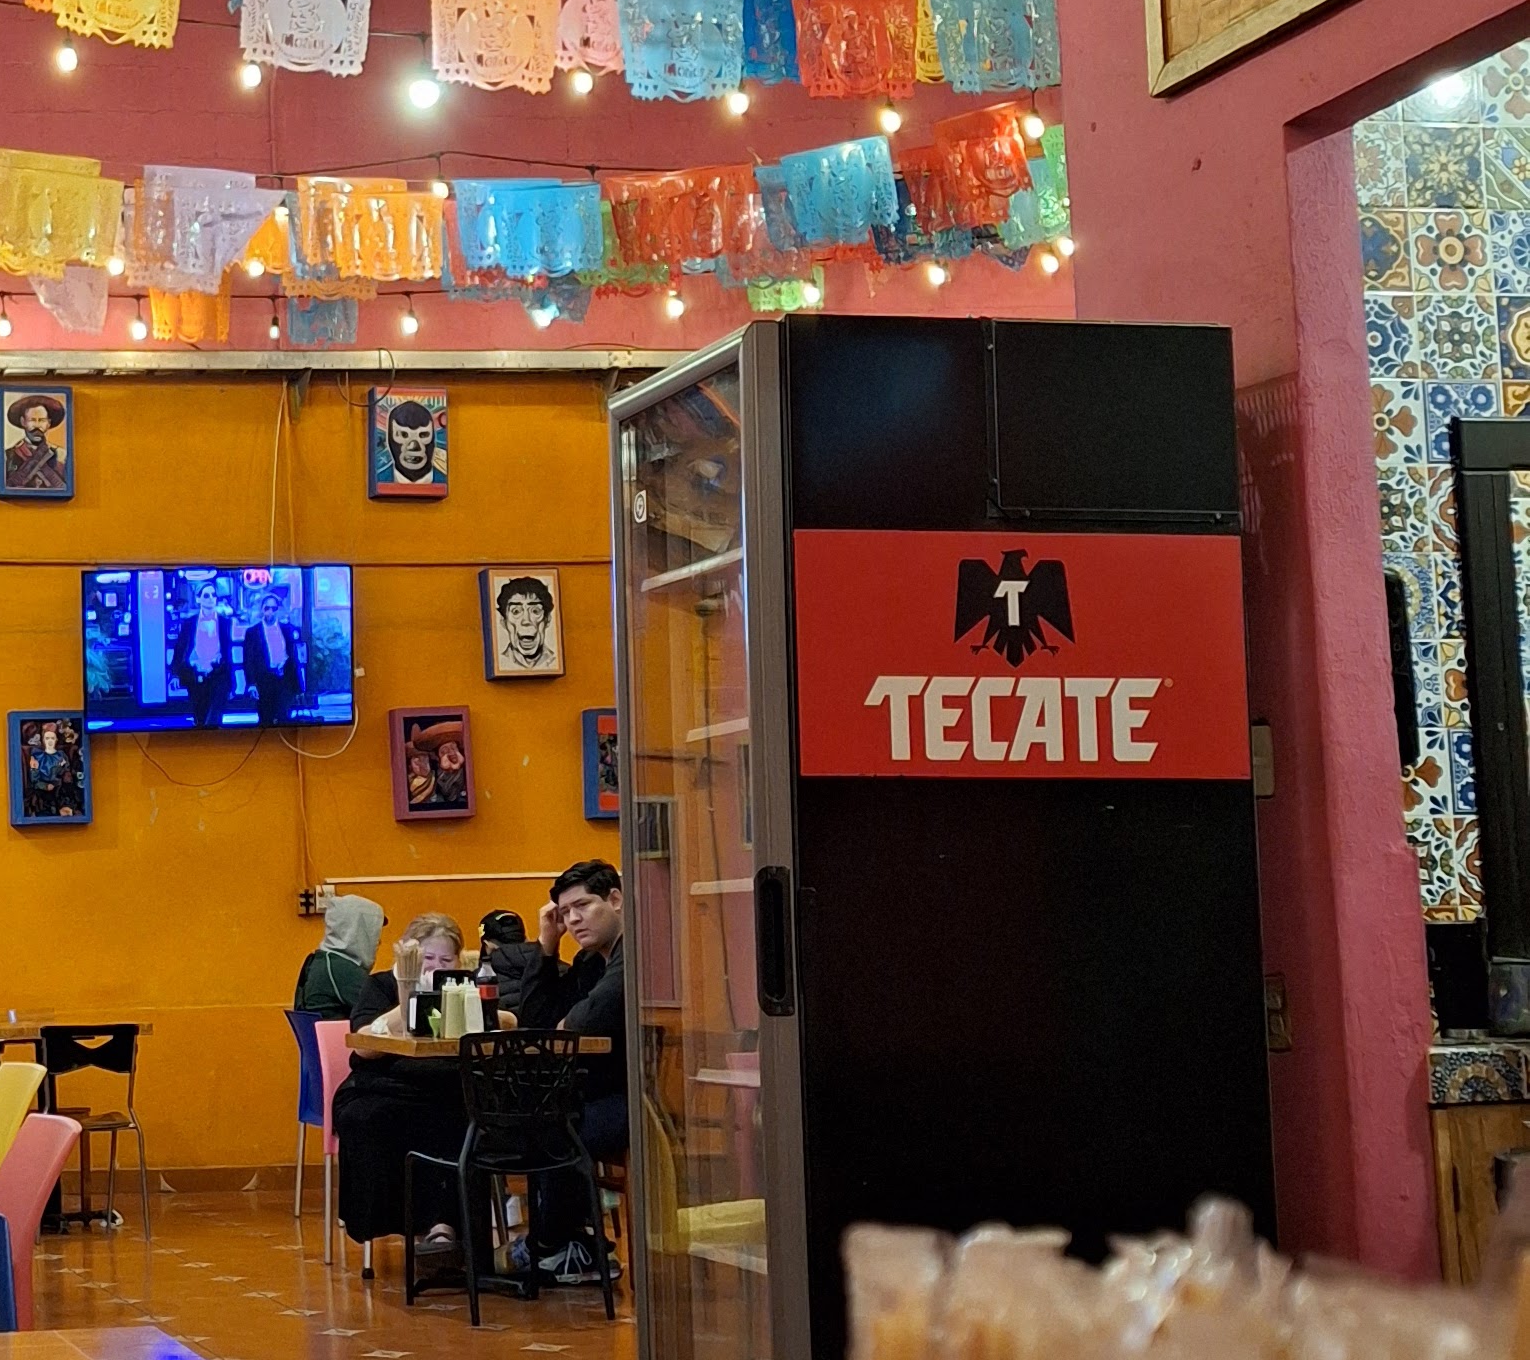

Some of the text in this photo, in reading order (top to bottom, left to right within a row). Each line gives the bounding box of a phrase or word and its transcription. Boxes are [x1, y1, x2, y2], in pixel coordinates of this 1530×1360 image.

[244, 568, 273, 584] OPEN
[993, 580, 1030, 627] T
[864, 675, 1163, 762] TECATE
